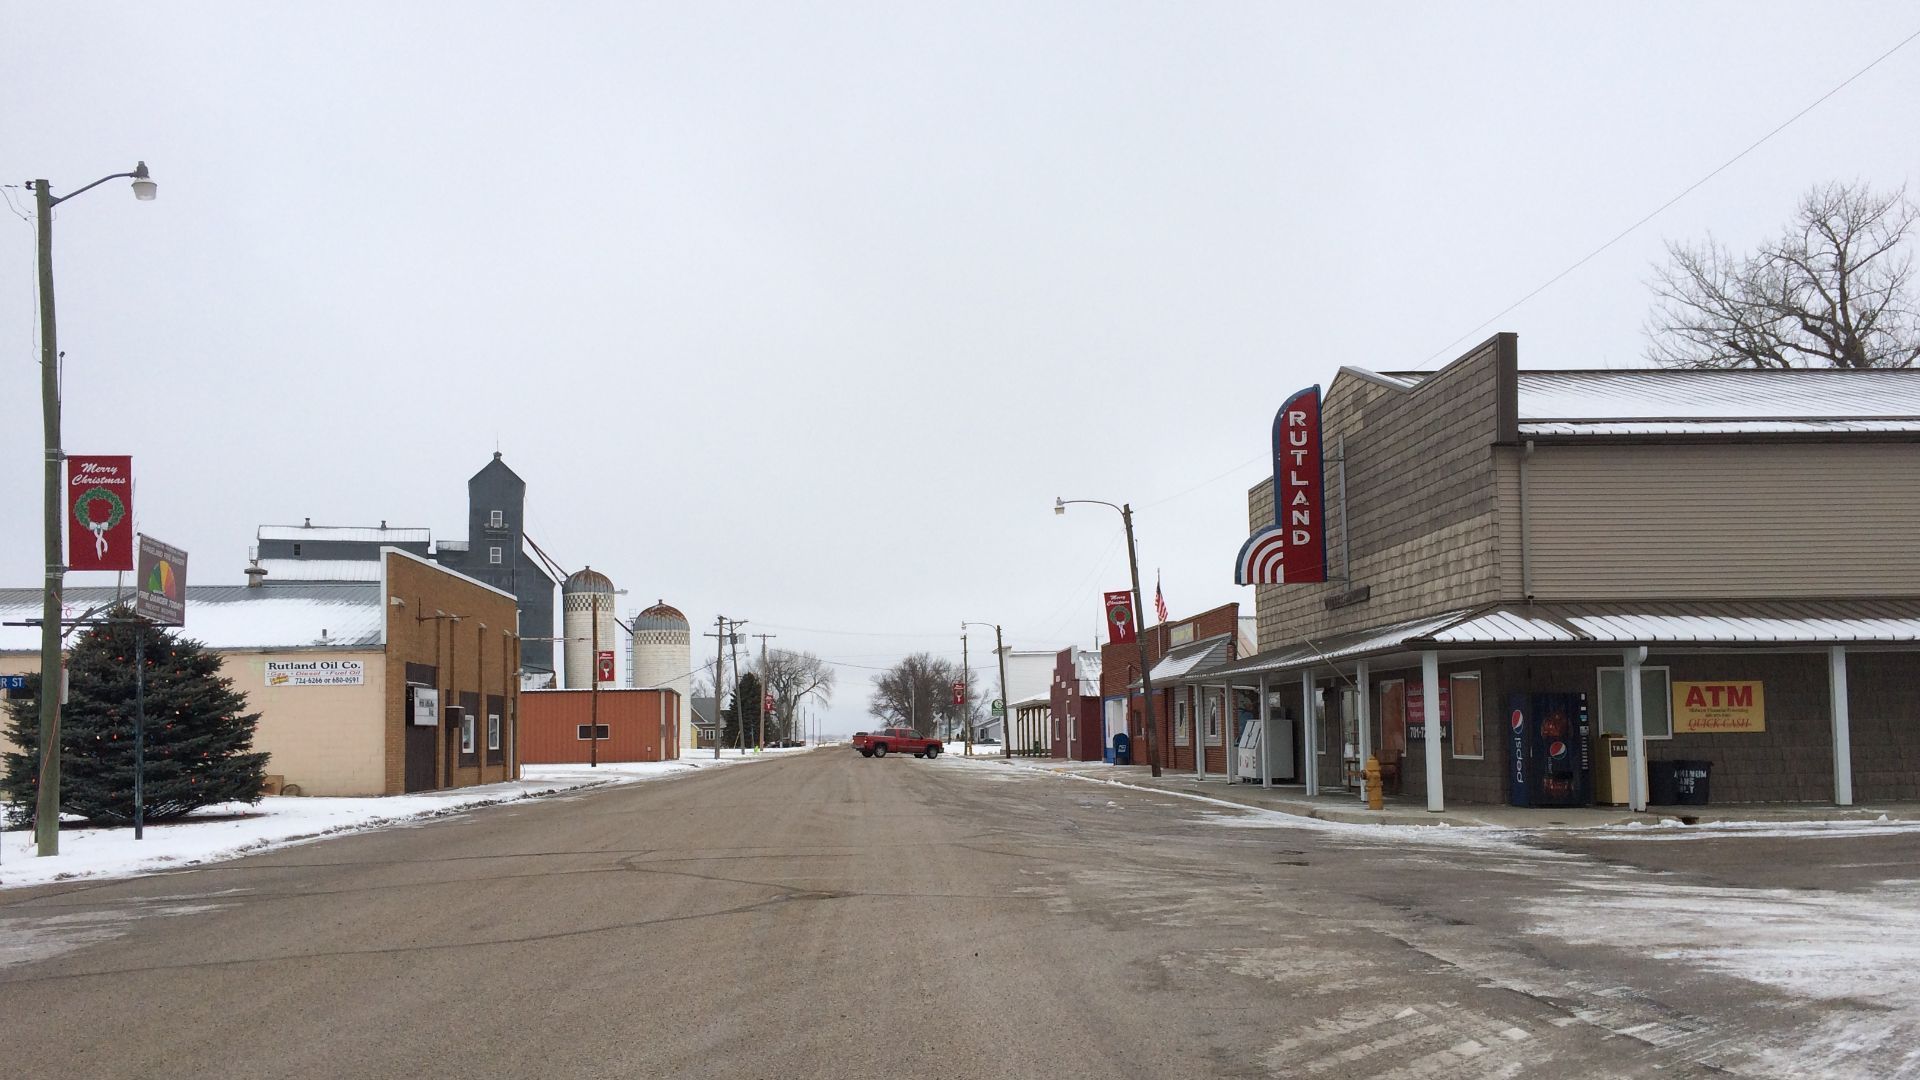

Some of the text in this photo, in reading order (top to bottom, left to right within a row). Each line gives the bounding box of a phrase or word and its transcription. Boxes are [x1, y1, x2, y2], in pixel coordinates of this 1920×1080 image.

[81, 463, 118, 475] Merry
[71, 474, 126, 486] Christmas
[1288, 410, 1311, 546] RUTLAND
[268, 661, 361, 671] Rutland Oil Co.
[12, 677, 23, 687] ST
[295, 677, 323, 685] 724-6266
[1685, 685, 1753, 707] ATM
[1514, 737, 1525, 783] pepsi
[1679, 777, 1695, 785] ANS
